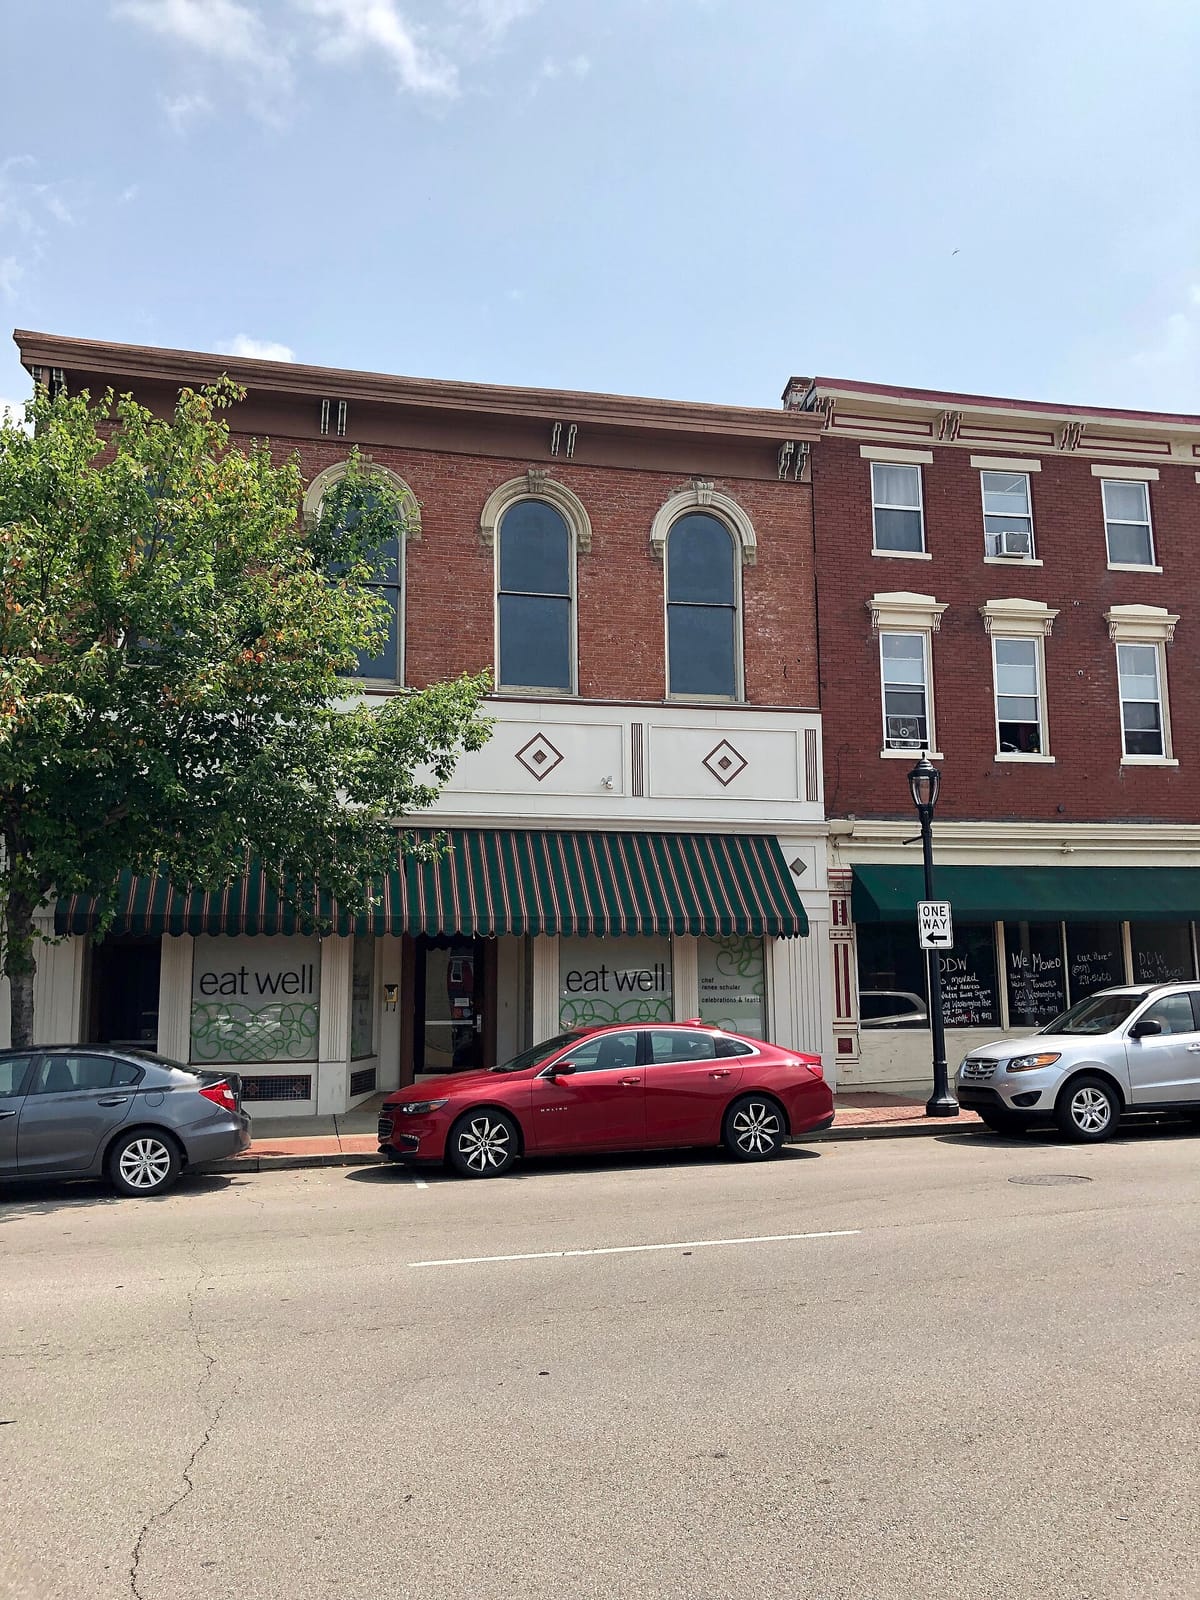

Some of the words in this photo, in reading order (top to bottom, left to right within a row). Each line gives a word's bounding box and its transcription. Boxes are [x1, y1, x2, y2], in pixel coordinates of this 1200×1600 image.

[923, 906, 946, 917] ONE
[922, 919, 948, 930] WAY
[1012, 950, 1030, 969] We
[200, 966, 249, 995] eat
[255, 964, 313, 994] well
[566, 964, 609, 992] eat
[614, 963, 665, 992] well
